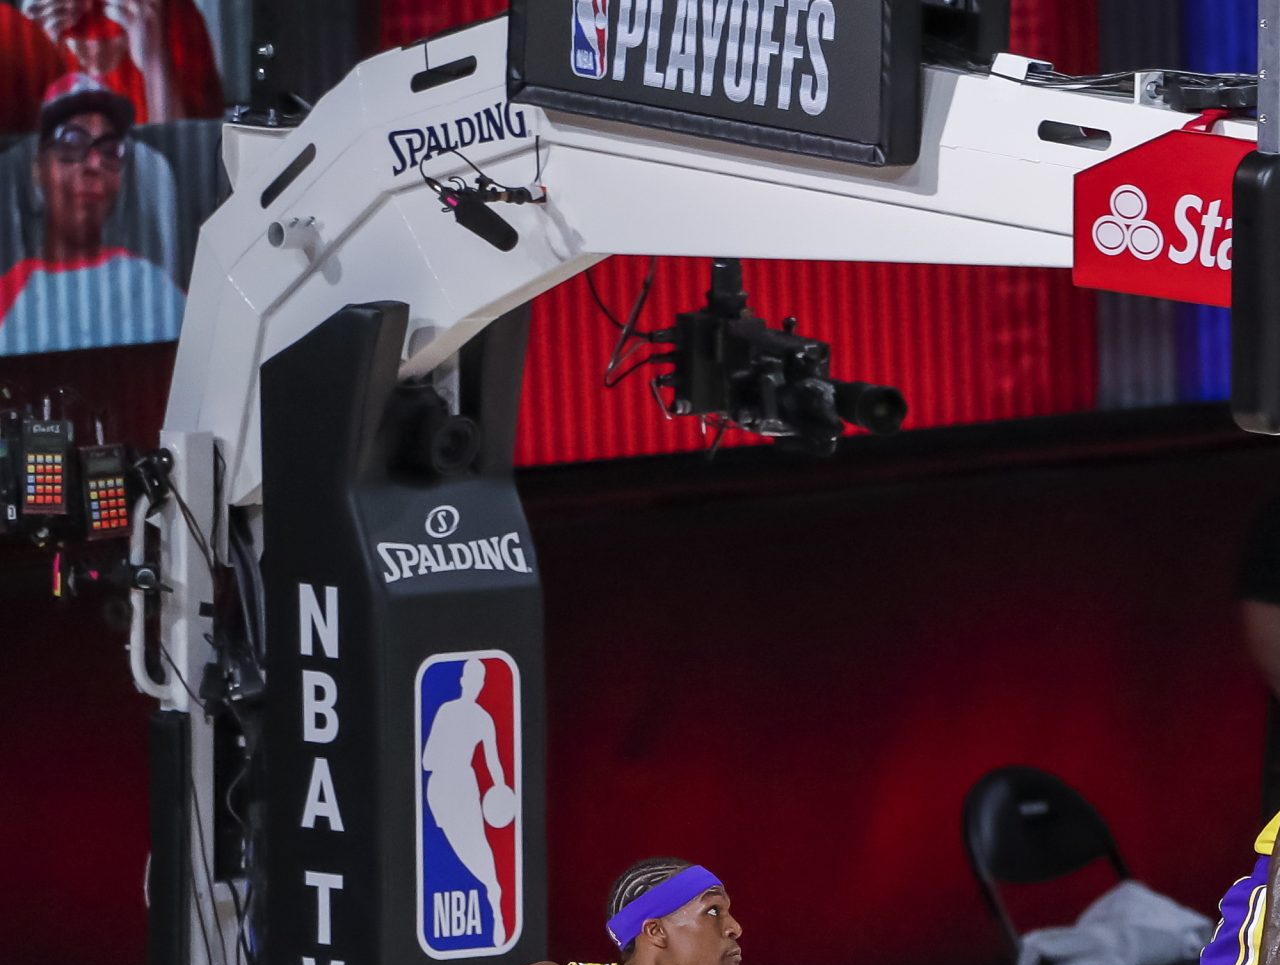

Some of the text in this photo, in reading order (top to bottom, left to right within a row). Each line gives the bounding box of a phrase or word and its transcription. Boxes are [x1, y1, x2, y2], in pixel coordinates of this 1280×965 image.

[612, 0, 836, 117] PLAYOFFS
[388, 101, 527, 177] SPALDING
[379, 531, 530, 583] SPALDING
[300, 583, 345, 832] NBA
[432, 889, 483, 939] NBA
